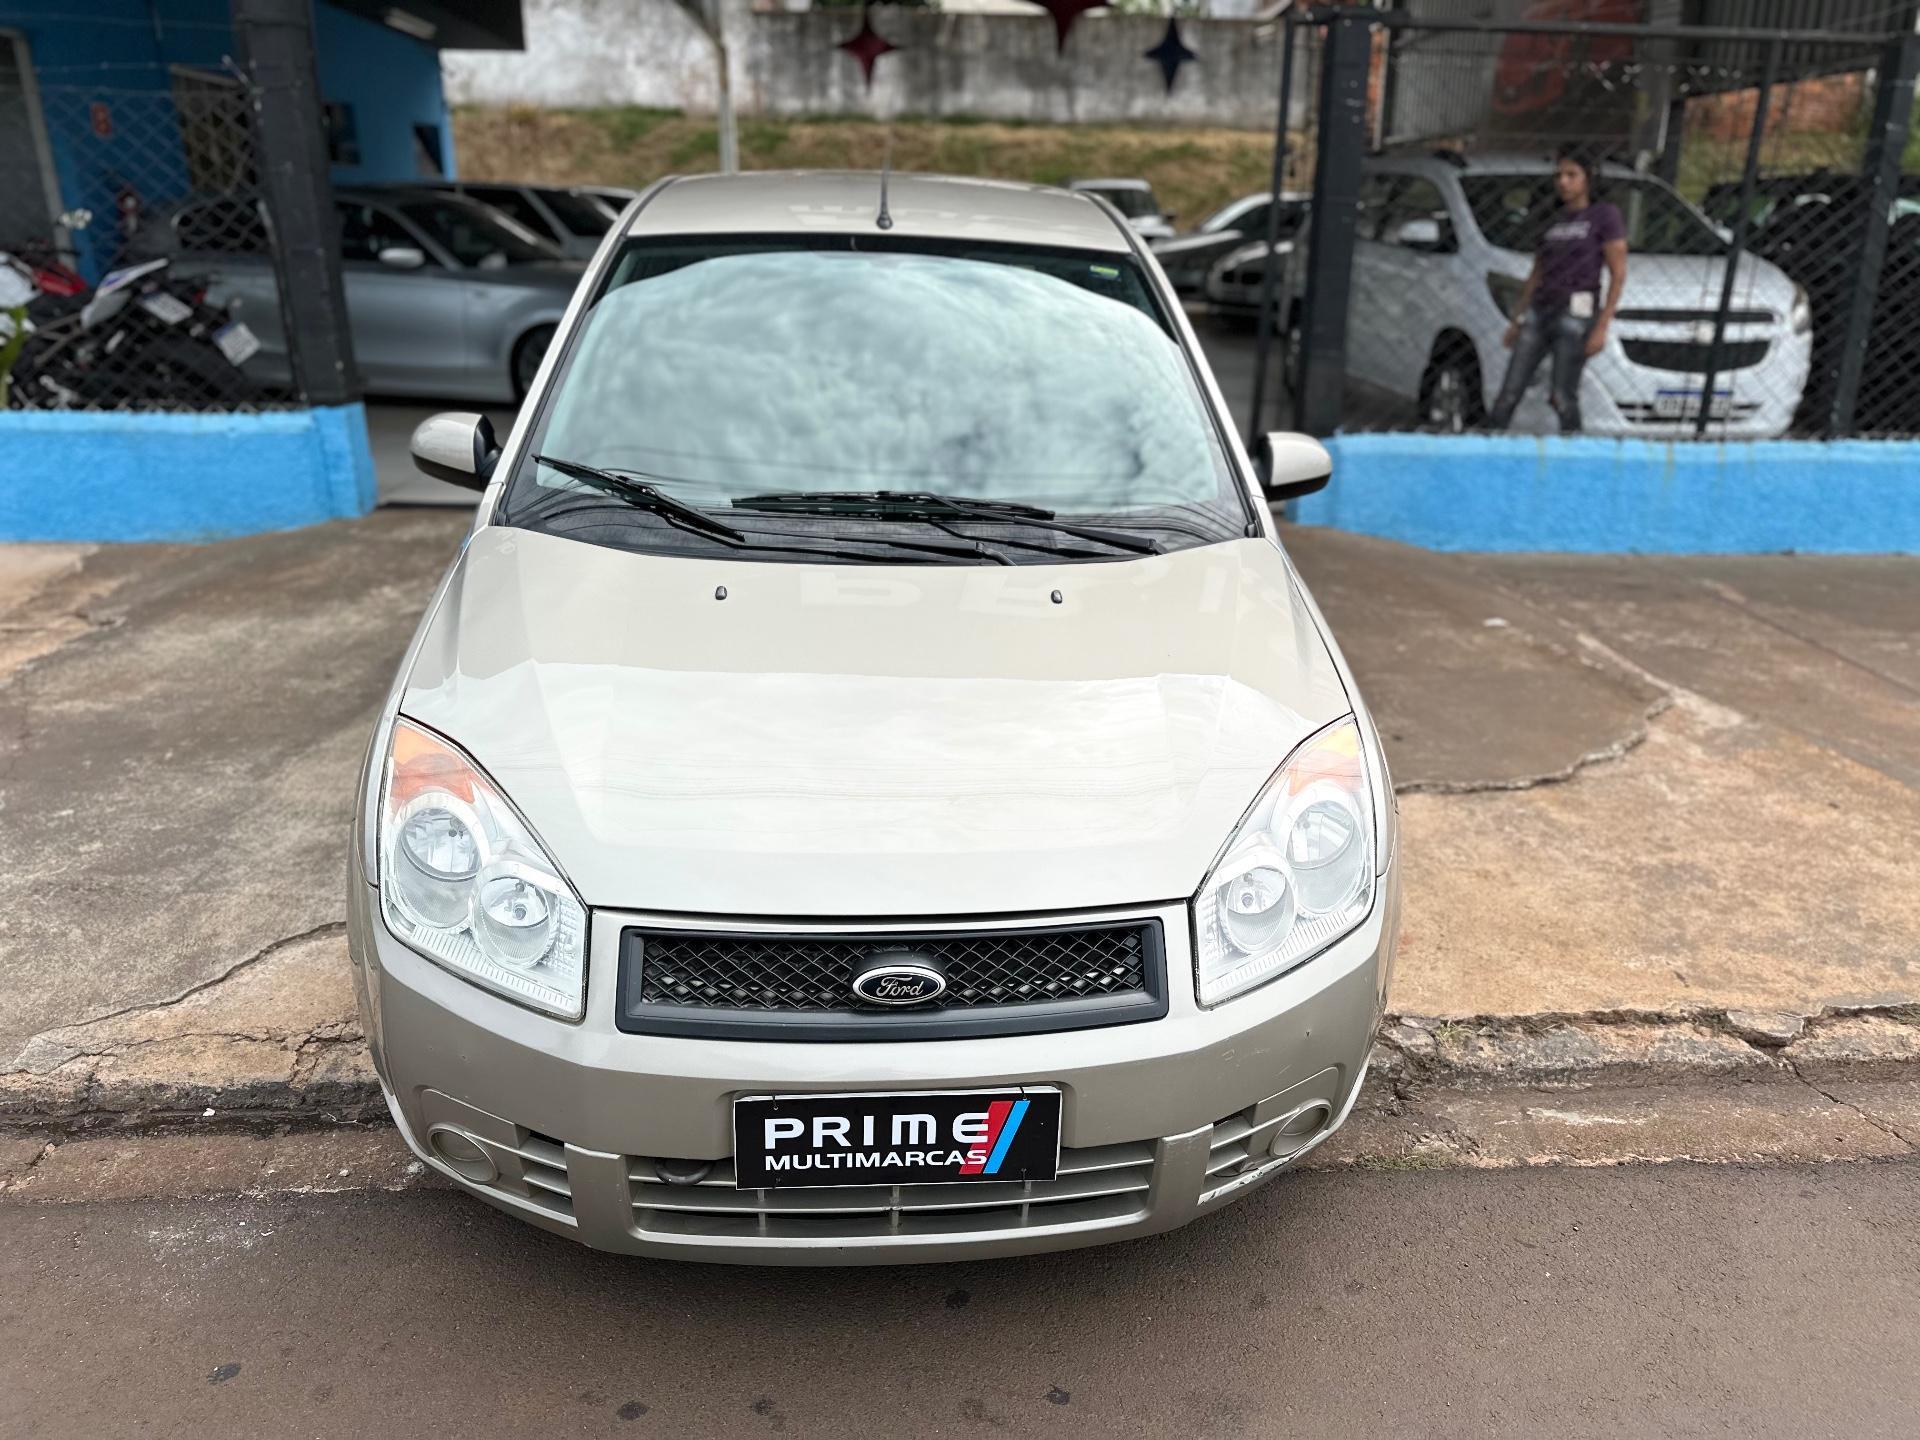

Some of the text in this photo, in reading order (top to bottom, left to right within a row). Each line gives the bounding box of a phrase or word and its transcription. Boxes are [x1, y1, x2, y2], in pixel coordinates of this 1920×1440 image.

[875, 976, 924, 997] Ford
[764, 1112, 989, 1150] PRIME
[765, 1150, 987, 1171] MULTIMARCAS
